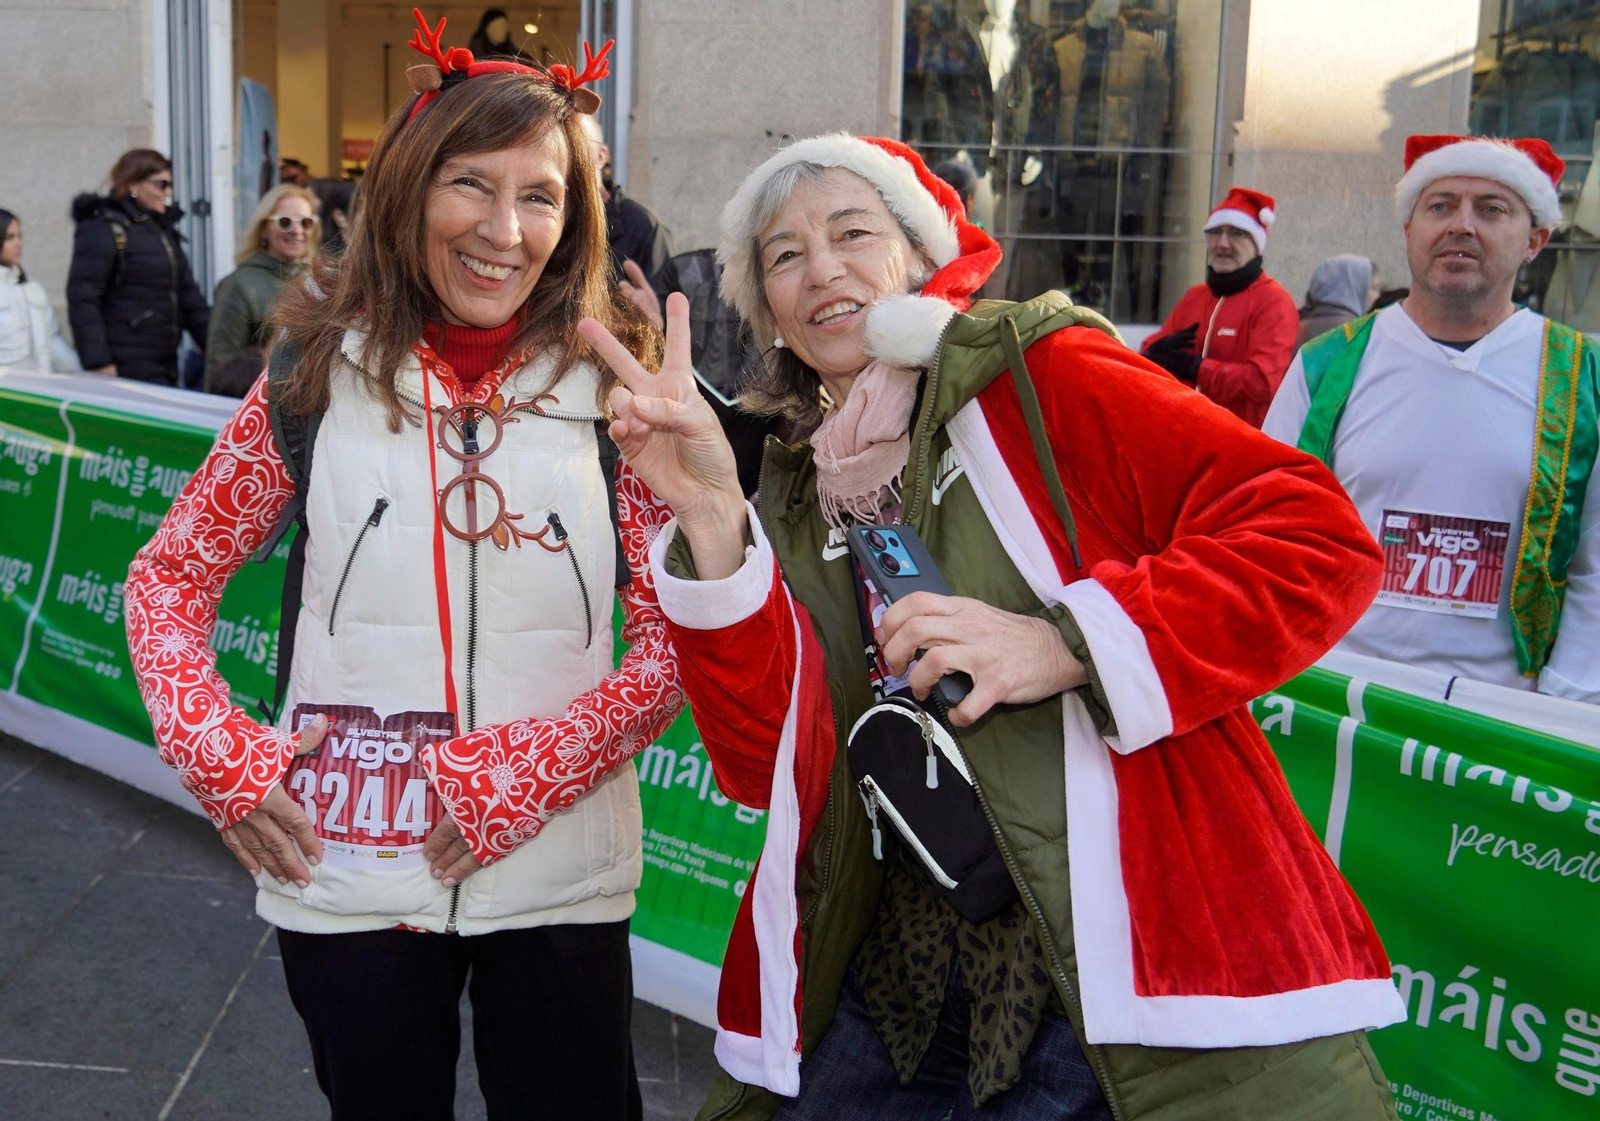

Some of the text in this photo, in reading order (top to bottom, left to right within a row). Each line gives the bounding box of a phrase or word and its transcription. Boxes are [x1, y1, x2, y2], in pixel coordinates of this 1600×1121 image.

[1416, 531, 1480, 555] vigo
[57, 570, 109, 614] máis
[1403, 553, 1478, 598] 707
[210, 615, 270, 665] máis
[330, 735, 413, 770] vigo
[347, 727, 403, 740] SILVESTRE
[290, 768, 432, 838] 3244
[1391, 964, 1600, 1097] máis que
